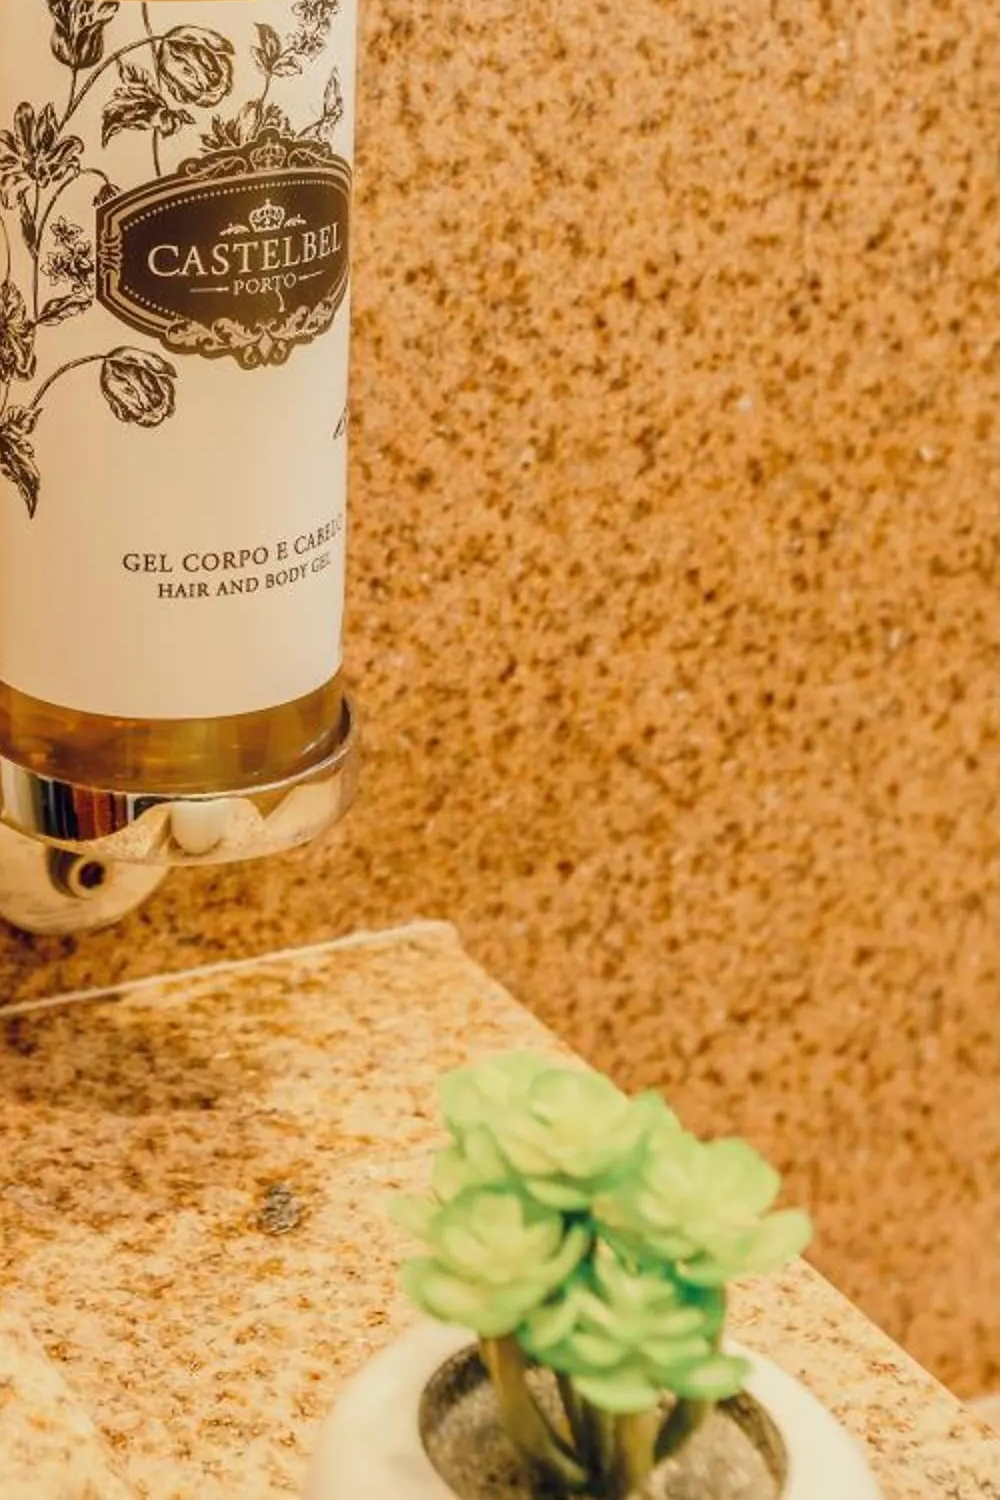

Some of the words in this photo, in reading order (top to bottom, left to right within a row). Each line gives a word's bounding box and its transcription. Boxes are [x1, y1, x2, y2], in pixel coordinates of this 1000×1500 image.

[147, 221, 342, 277] CASTELBEL
[232, 272, 298, 312] PORTO
[122, 553, 173, 573] GEL
[182, 546, 270, 573] CORPO
[276, 541, 289, 561] E
[157, 582, 210, 599] HAIR
[216, 577, 259, 597] AND
[265, 564, 308, 589] BODY
